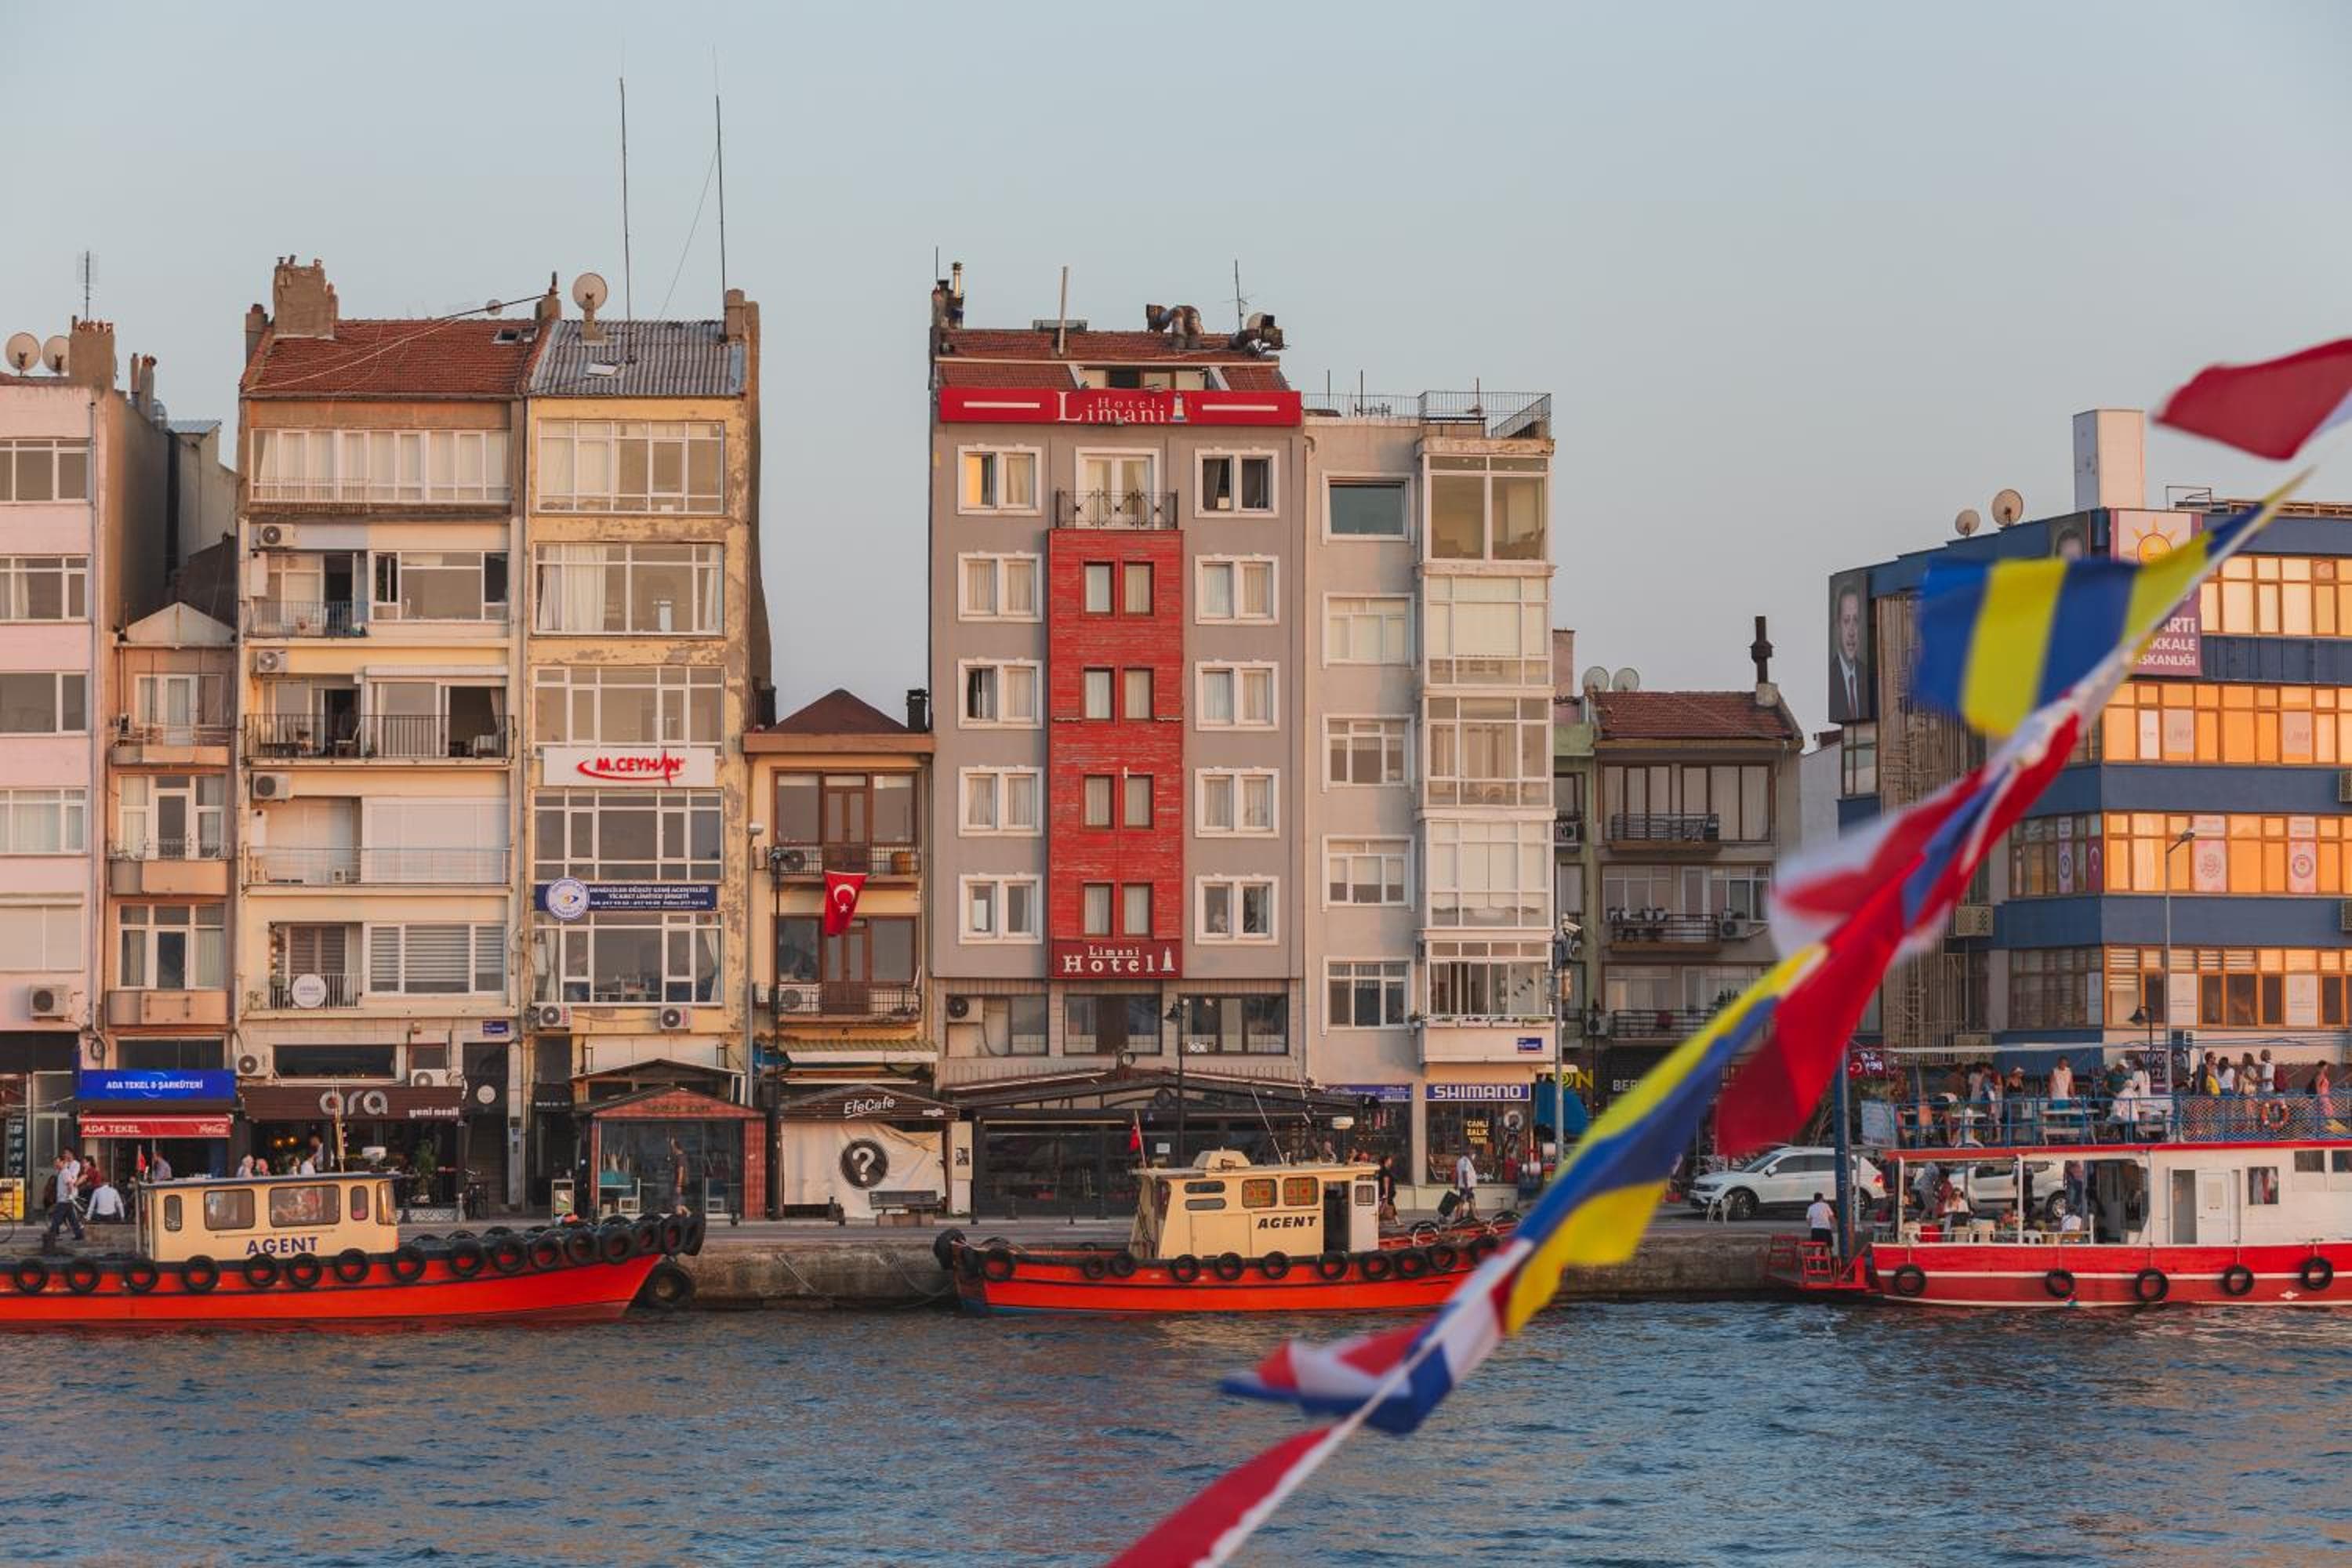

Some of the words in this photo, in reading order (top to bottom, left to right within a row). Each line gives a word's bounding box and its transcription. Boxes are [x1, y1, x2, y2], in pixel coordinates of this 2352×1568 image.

[1056, 391, 1166, 422] Limani
[1098, 397, 1155, 408] Hotel
[2149, 638, 2196, 651] KKALE
[2138, 654, 2196, 666] ŞKANLIĞI
[1088, 945, 1140, 956] Limani
[1063, 955, 1155, 973] Hotel
[106, 1080, 123, 1090] ADA
[125, 1080, 150, 1090] TEKEL
[1434, 1085, 1522, 1098] SHIMANO
[84, 1125, 106, 1134] ADA
[108, 1125, 140, 1134] TEKEL
[1257, 1216, 1317, 1230] AGENT
[245, 1236, 319, 1255] AGENT
